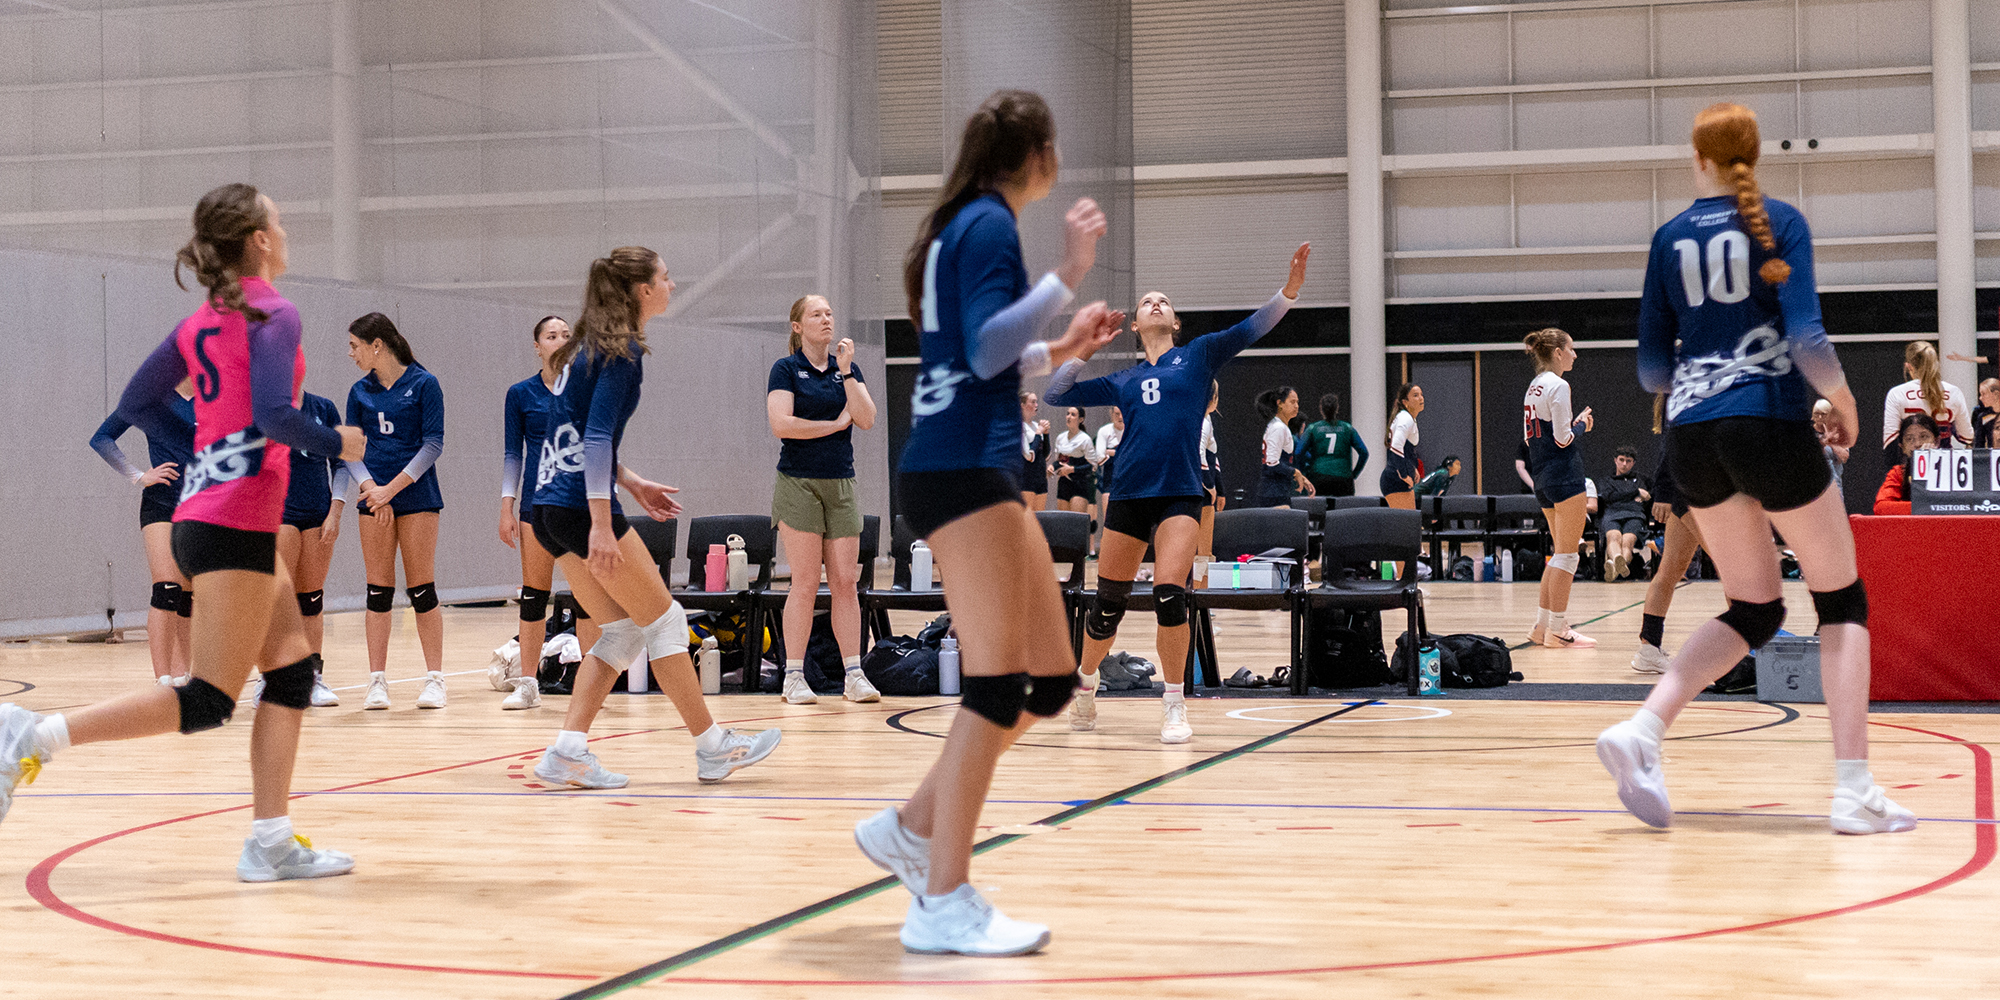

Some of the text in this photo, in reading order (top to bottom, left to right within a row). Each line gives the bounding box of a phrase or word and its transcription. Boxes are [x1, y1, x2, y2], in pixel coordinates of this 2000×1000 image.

[1673, 230, 1750, 307] 10
[194, 327, 222, 403] 5
[1141, 378, 1161, 405] 8
[1905, 390, 1951, 400] CGS
[1325, 432, 1337, 454] 7
[1917, 455, 1927, 478] 0
[1930, 504, 1971, 512] VISITORS
[1786, 674, 1799, 690] 5
